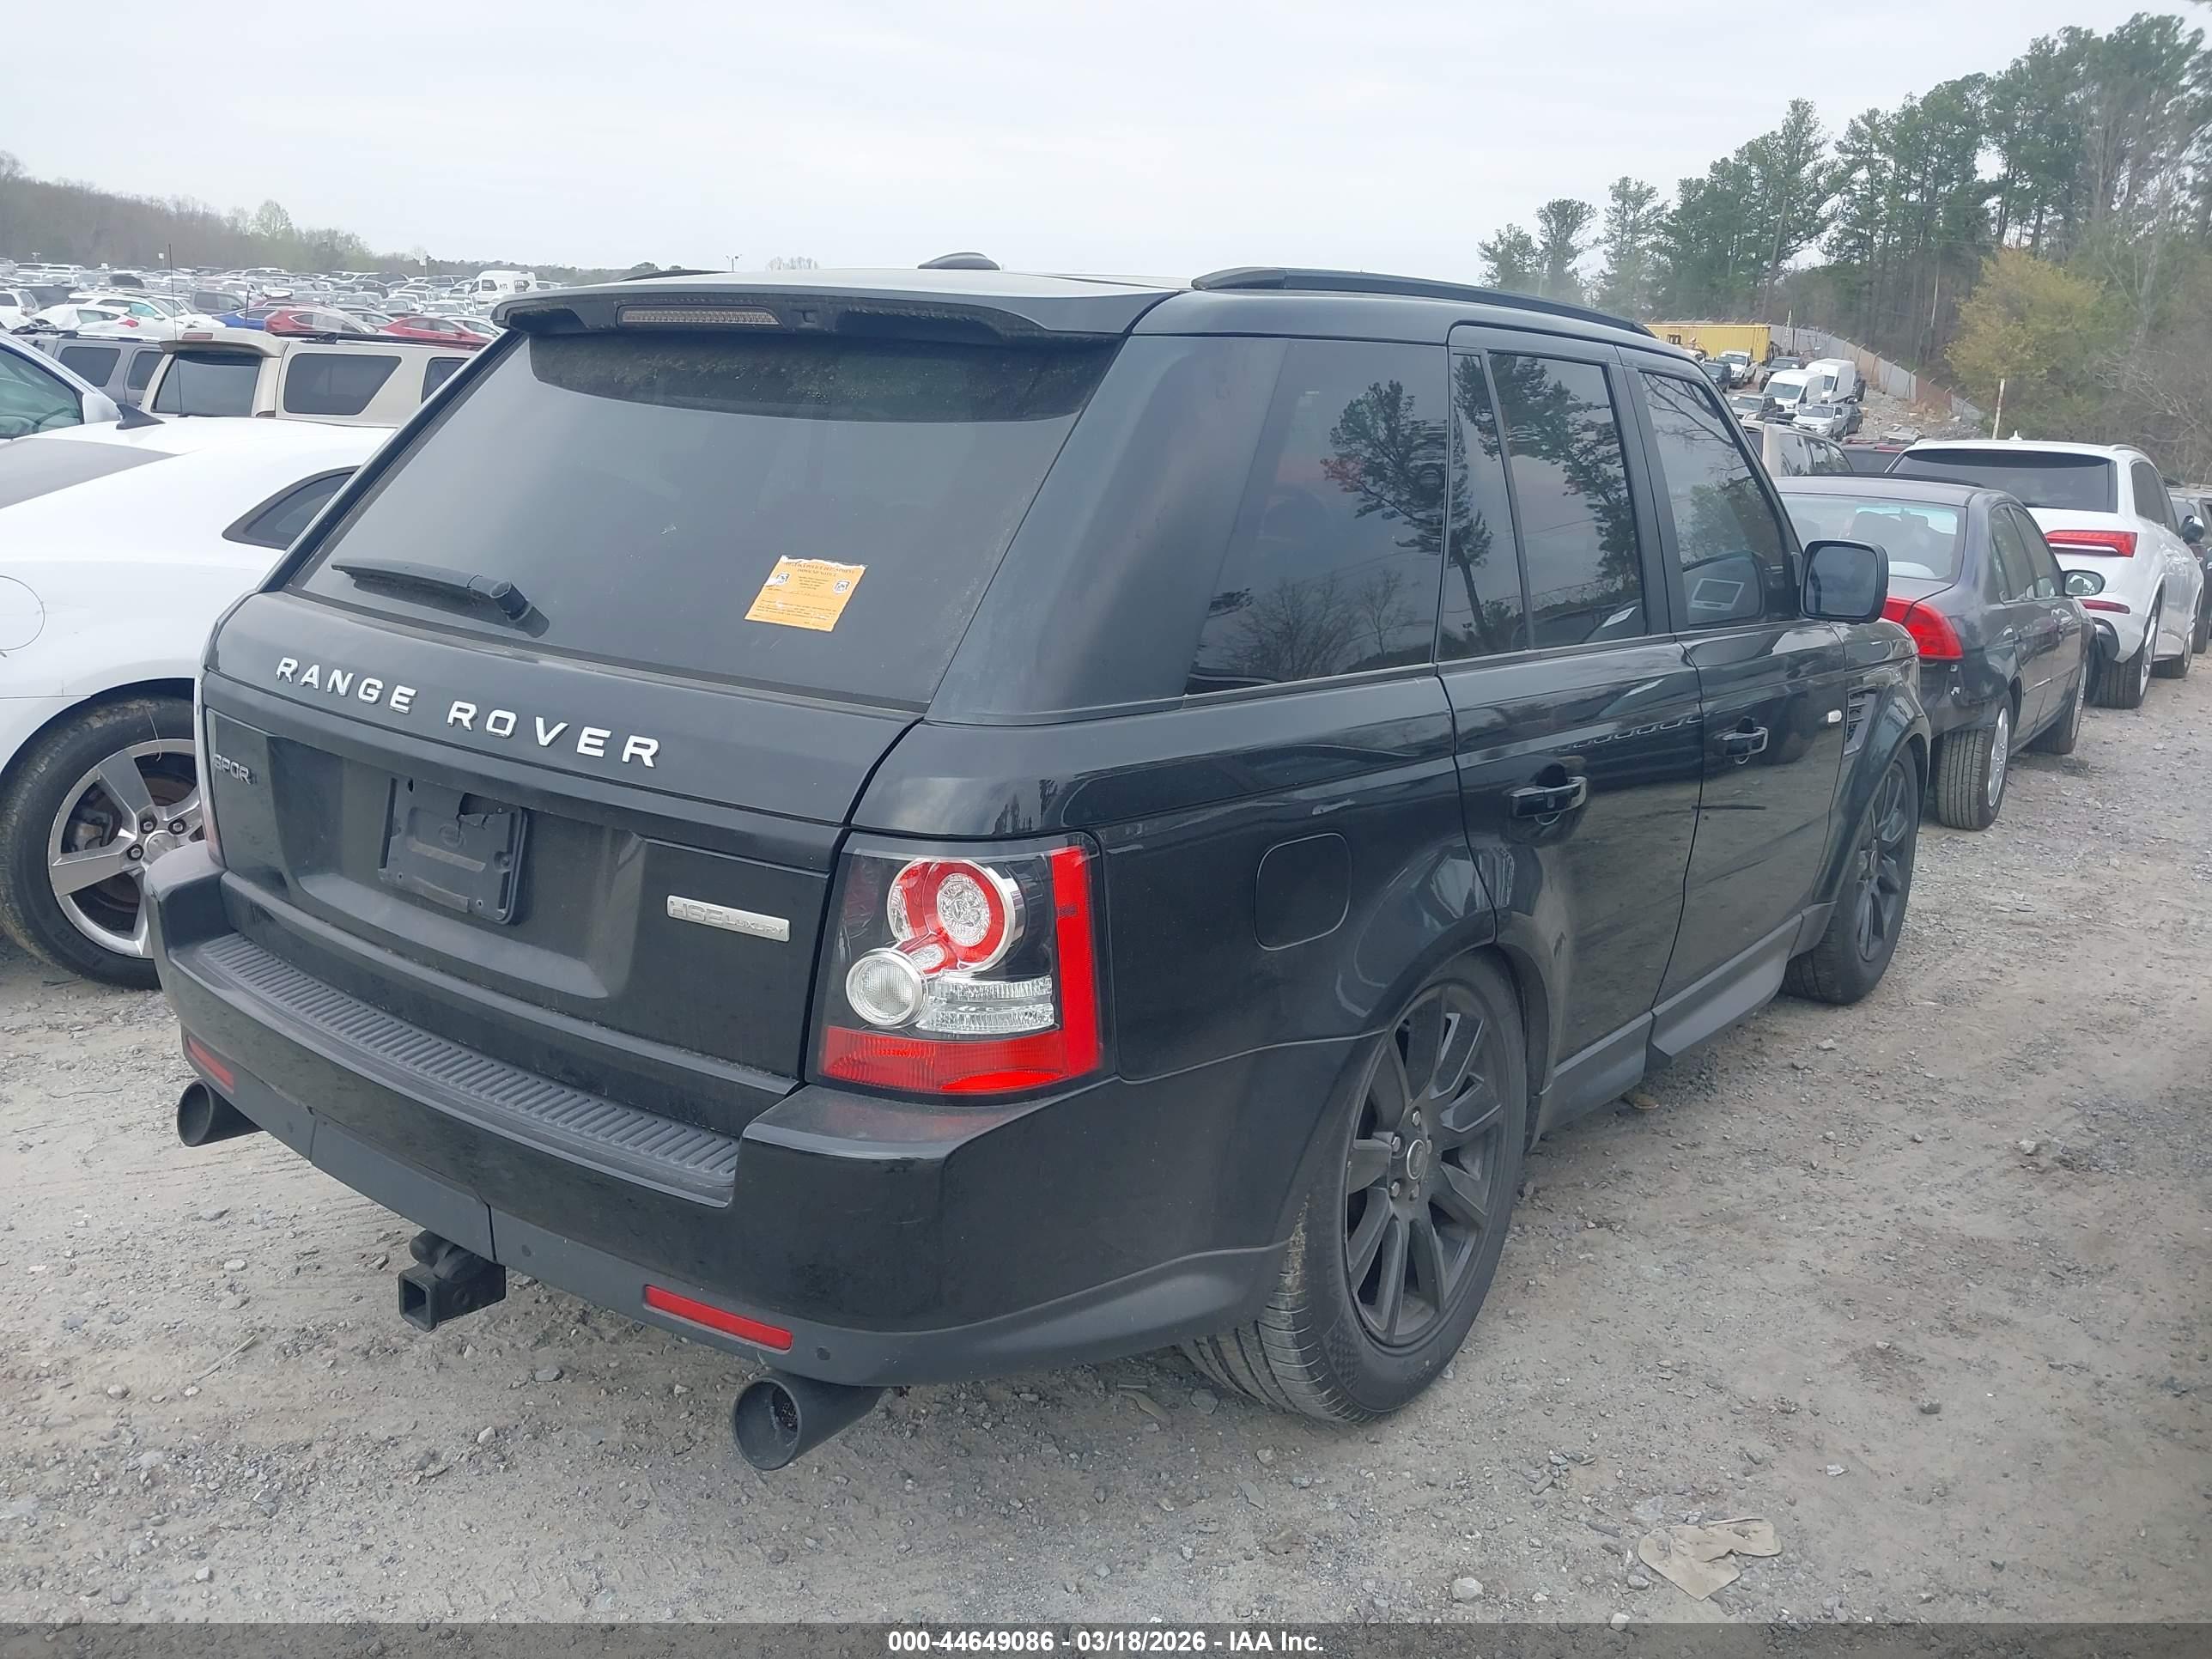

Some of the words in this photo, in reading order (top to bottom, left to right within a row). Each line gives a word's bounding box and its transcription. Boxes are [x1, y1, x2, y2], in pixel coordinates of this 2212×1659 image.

[276, 656, 416, 714] RANGE
[447, 700, 660, 769] ROVER
[213, 753, 258, 785] SPOR
[670, 900, 723, 927] HSE
